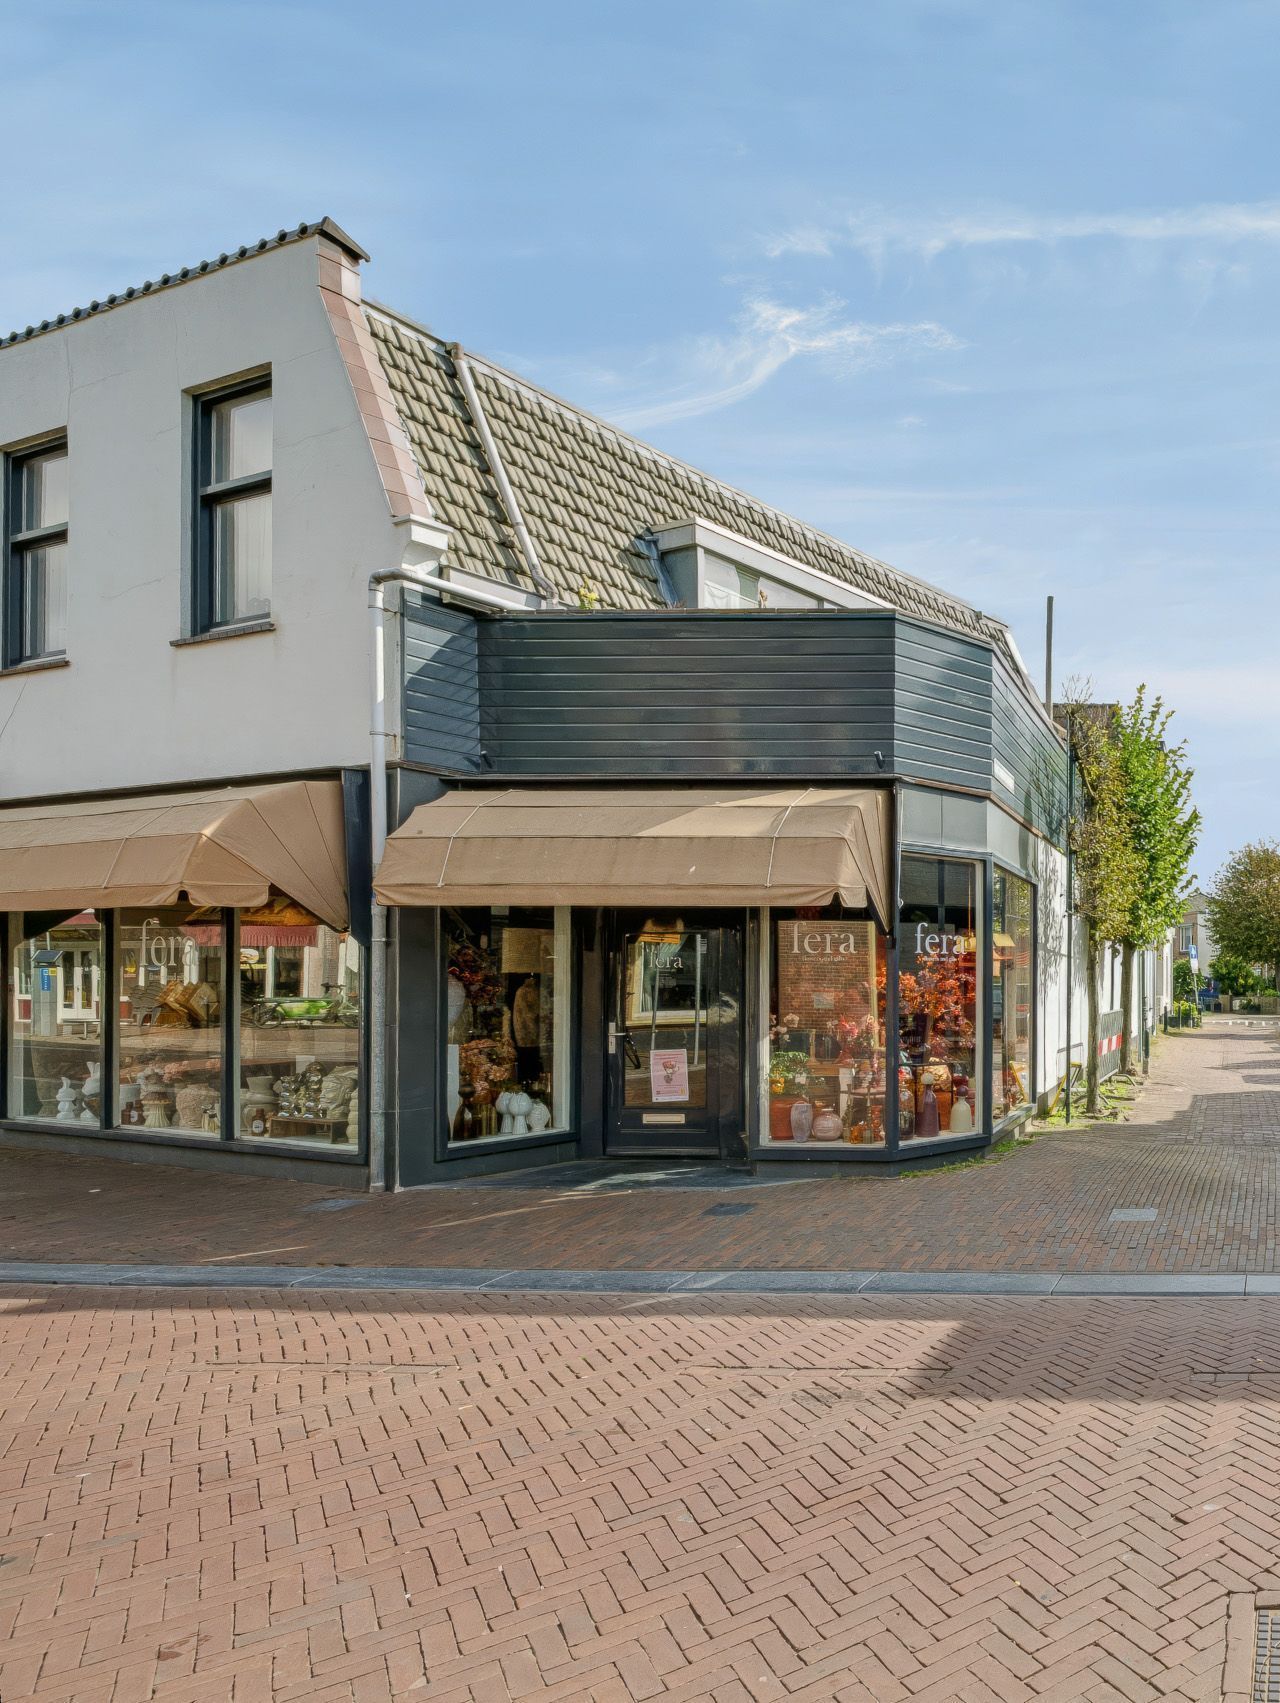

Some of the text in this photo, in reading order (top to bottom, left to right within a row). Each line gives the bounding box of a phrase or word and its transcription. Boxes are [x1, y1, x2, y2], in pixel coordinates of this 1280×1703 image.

[139, 918, 198, 967] fera
[791, 921, 858, 954] fera
[914, 922, 967, 955] fera
